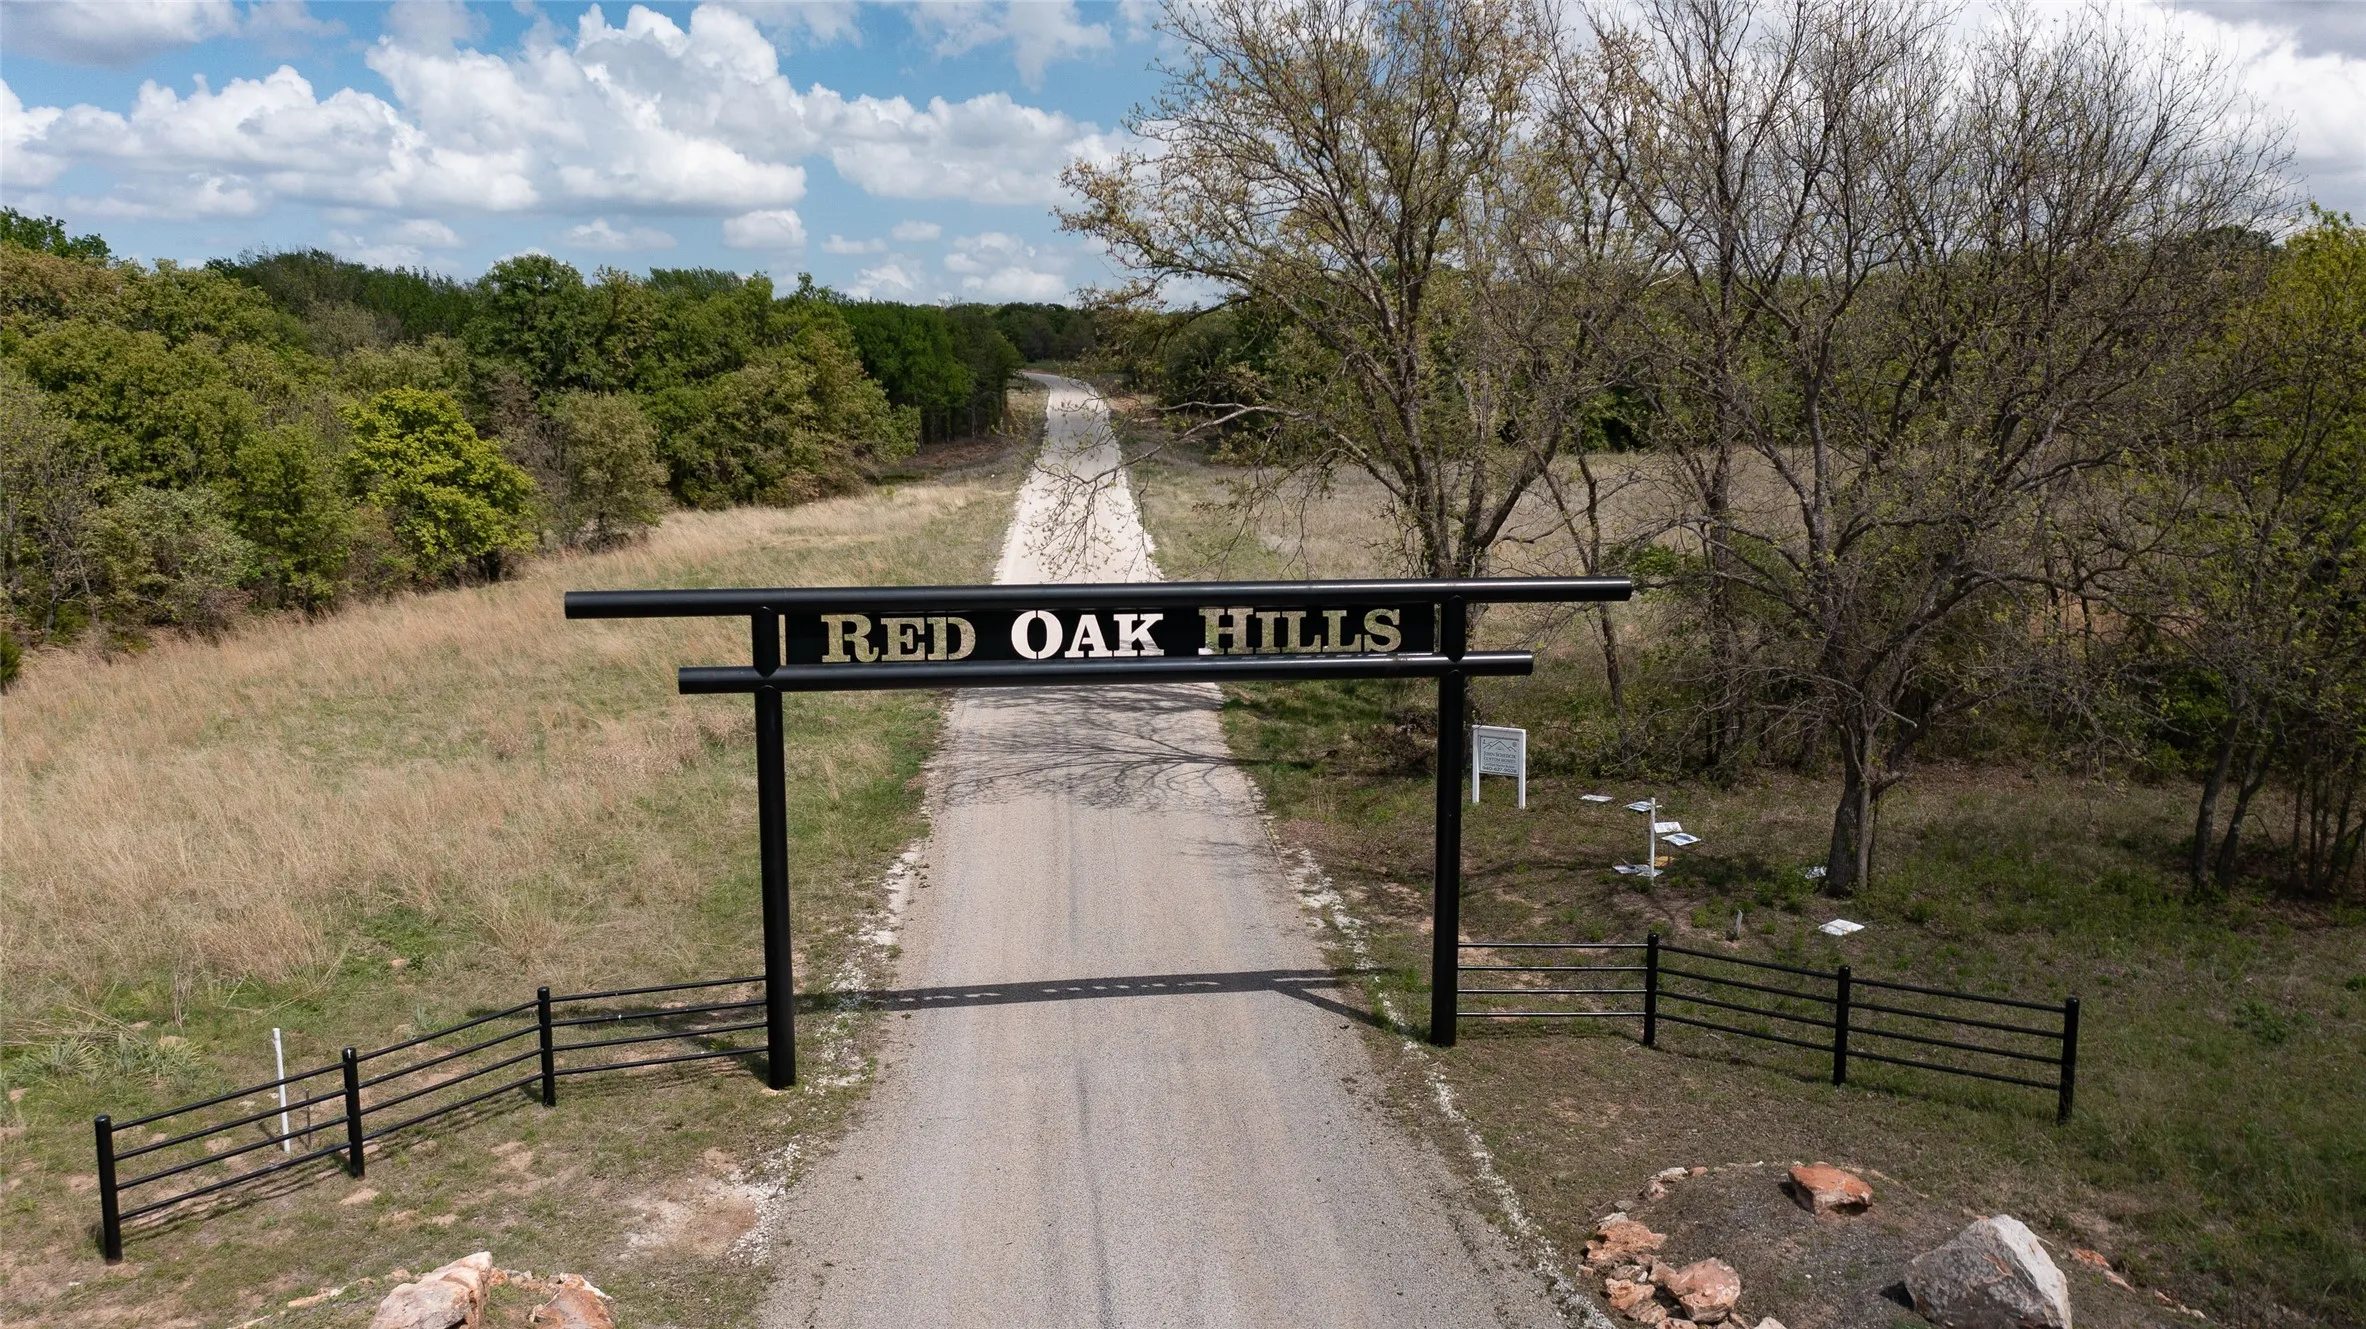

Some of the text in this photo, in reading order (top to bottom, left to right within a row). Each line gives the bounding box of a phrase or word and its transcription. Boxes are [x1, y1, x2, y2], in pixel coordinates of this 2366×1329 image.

[820, 607, 1402, 663] RED OAK HILLS
